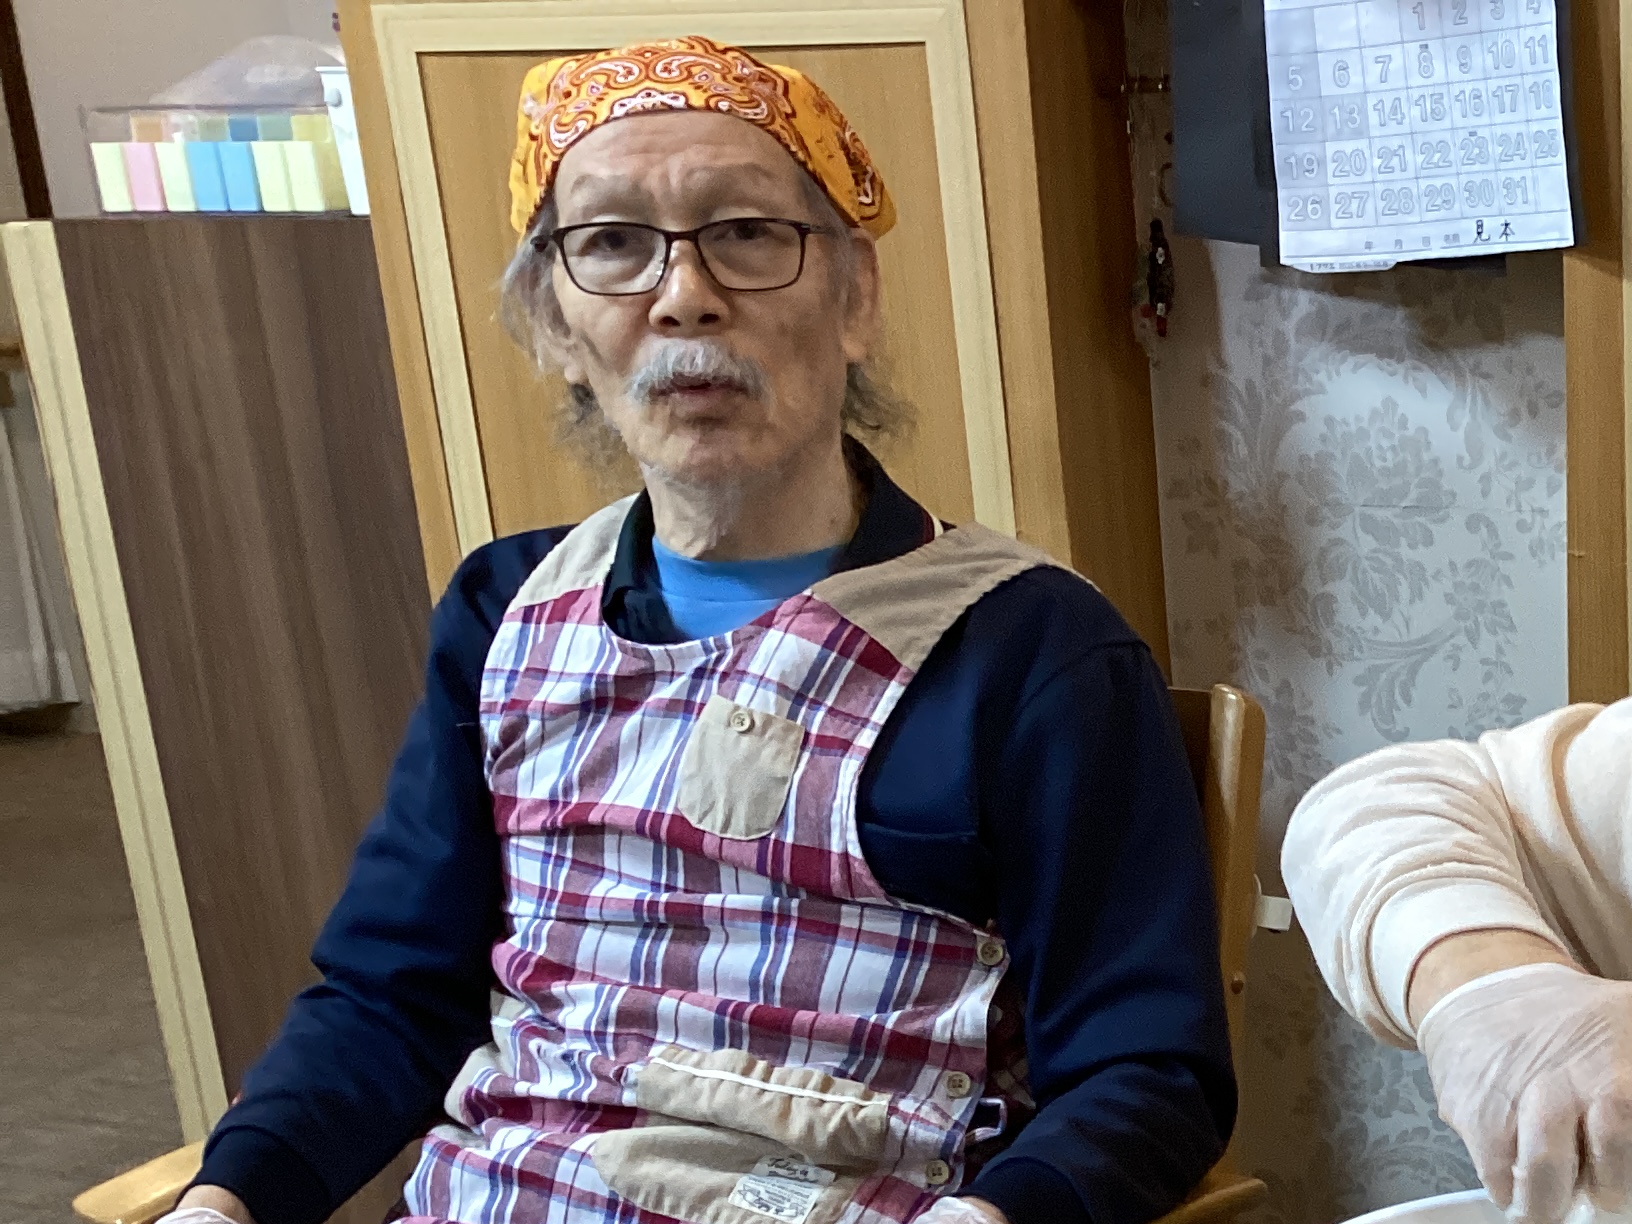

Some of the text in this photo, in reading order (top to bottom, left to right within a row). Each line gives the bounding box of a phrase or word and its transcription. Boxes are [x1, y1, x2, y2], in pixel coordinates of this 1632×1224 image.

[1412, 2, 1426, 30] 1
[1452, 0, 1468, 25] 2
[1288, 34, 1549, 91] 5 6 7 8 9 10 11
[1280, 79, 1553, 132] 12 13 14 15 16 17 18
[1284, 129, 1560, 180] 19 20 21 22 23 24 25
[1286, 176, 1529, 221] 26 27 28 29 30 31
